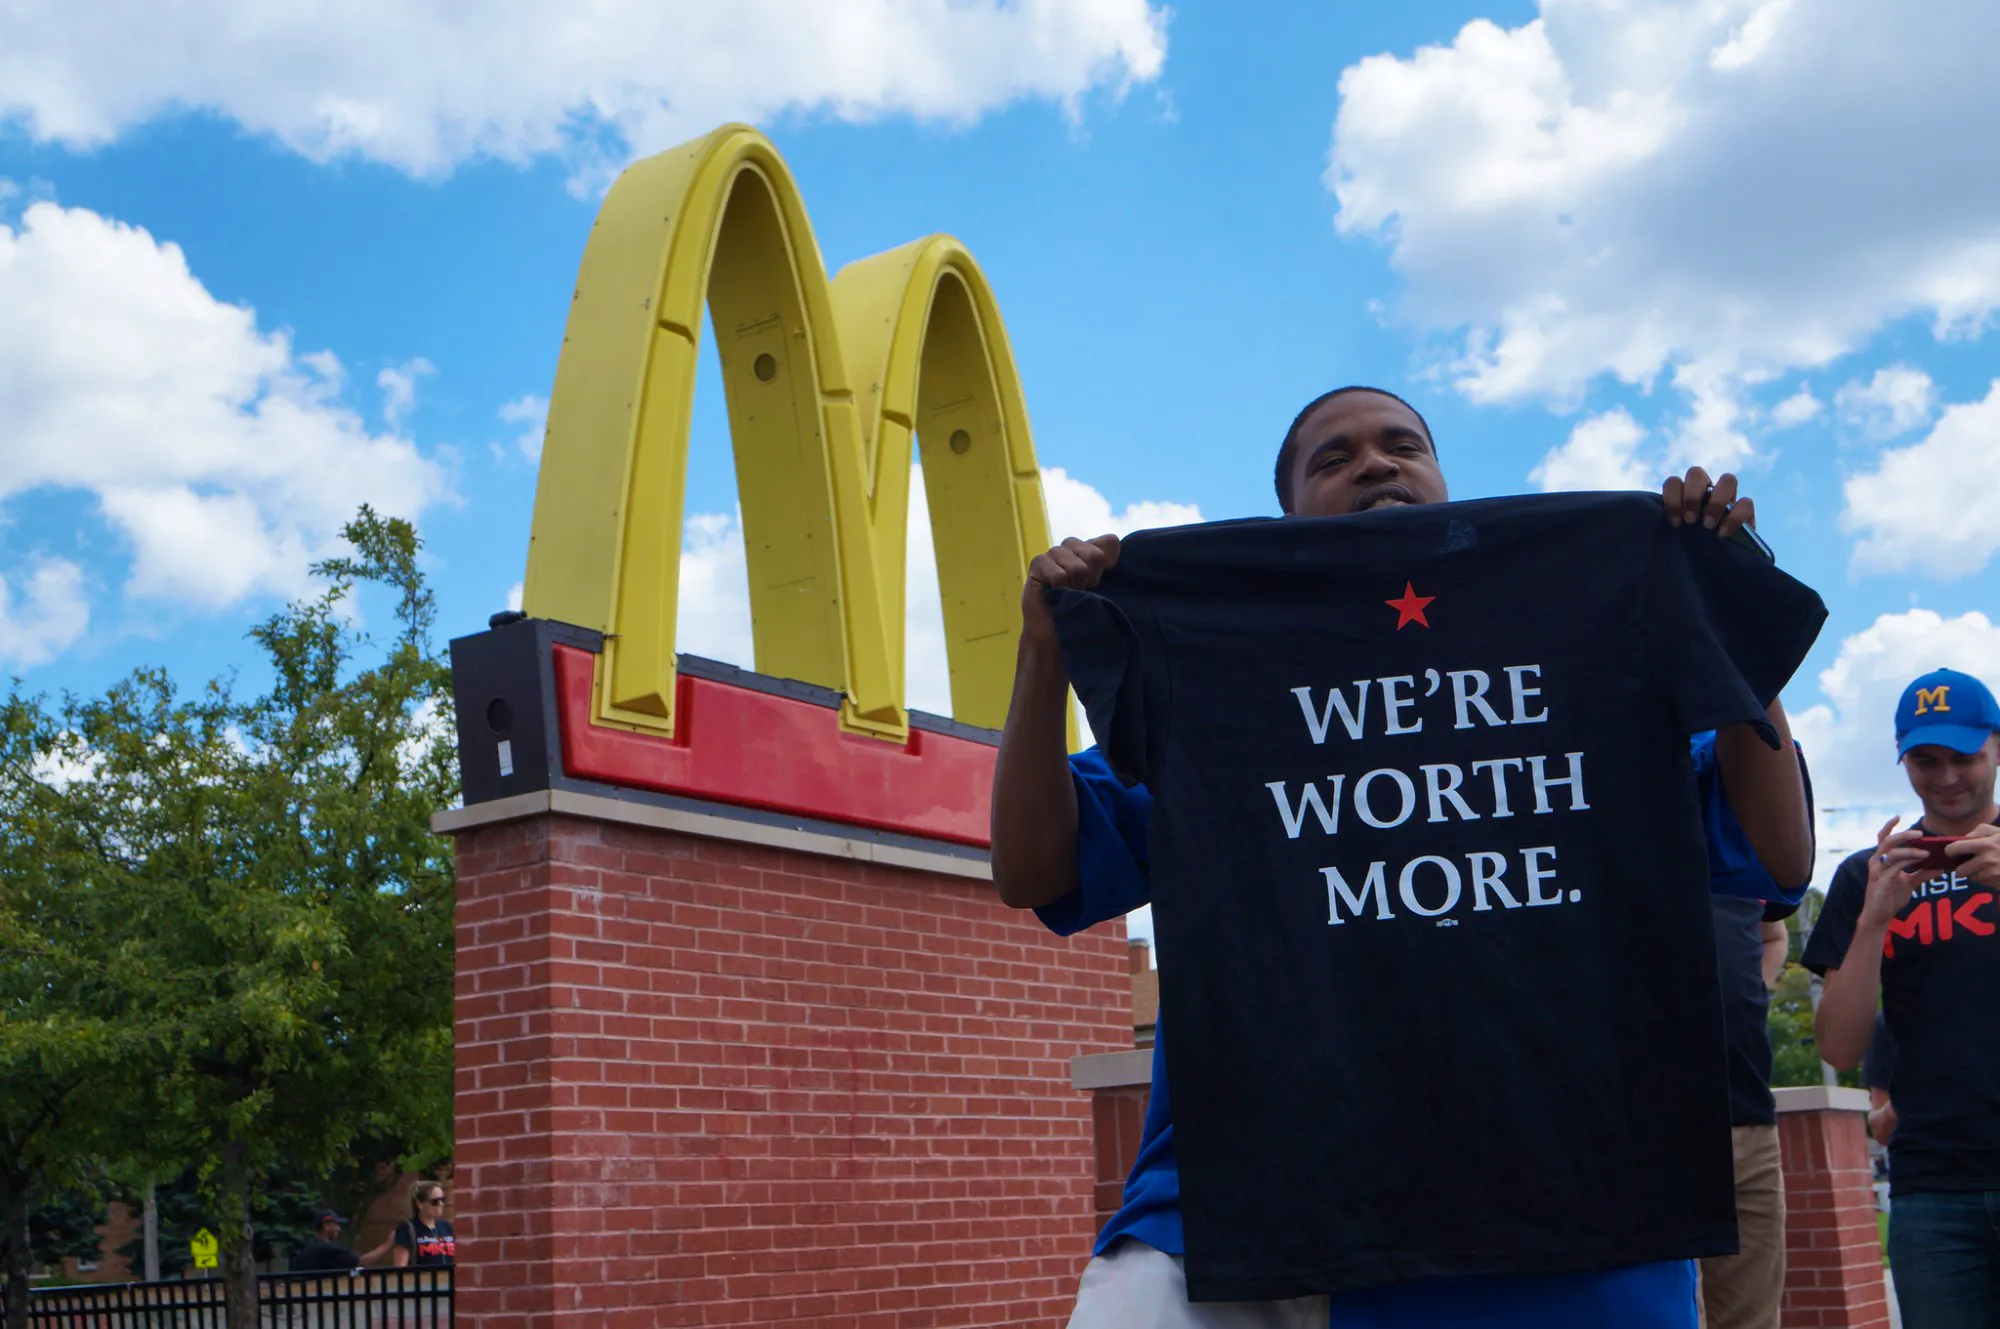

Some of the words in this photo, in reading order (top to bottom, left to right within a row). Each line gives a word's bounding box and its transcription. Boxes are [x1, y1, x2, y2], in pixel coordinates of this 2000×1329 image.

[1290, 664, 1549, 744] WE’RE
[1914, 685, 1951, 715] M
[1265, 751, 1591, 839] WORTH
[1318, 846, 1582, 926] MORE.
[1911, 870, 1968, 898] ISE
[1883, 892, 2000, 959] MK
